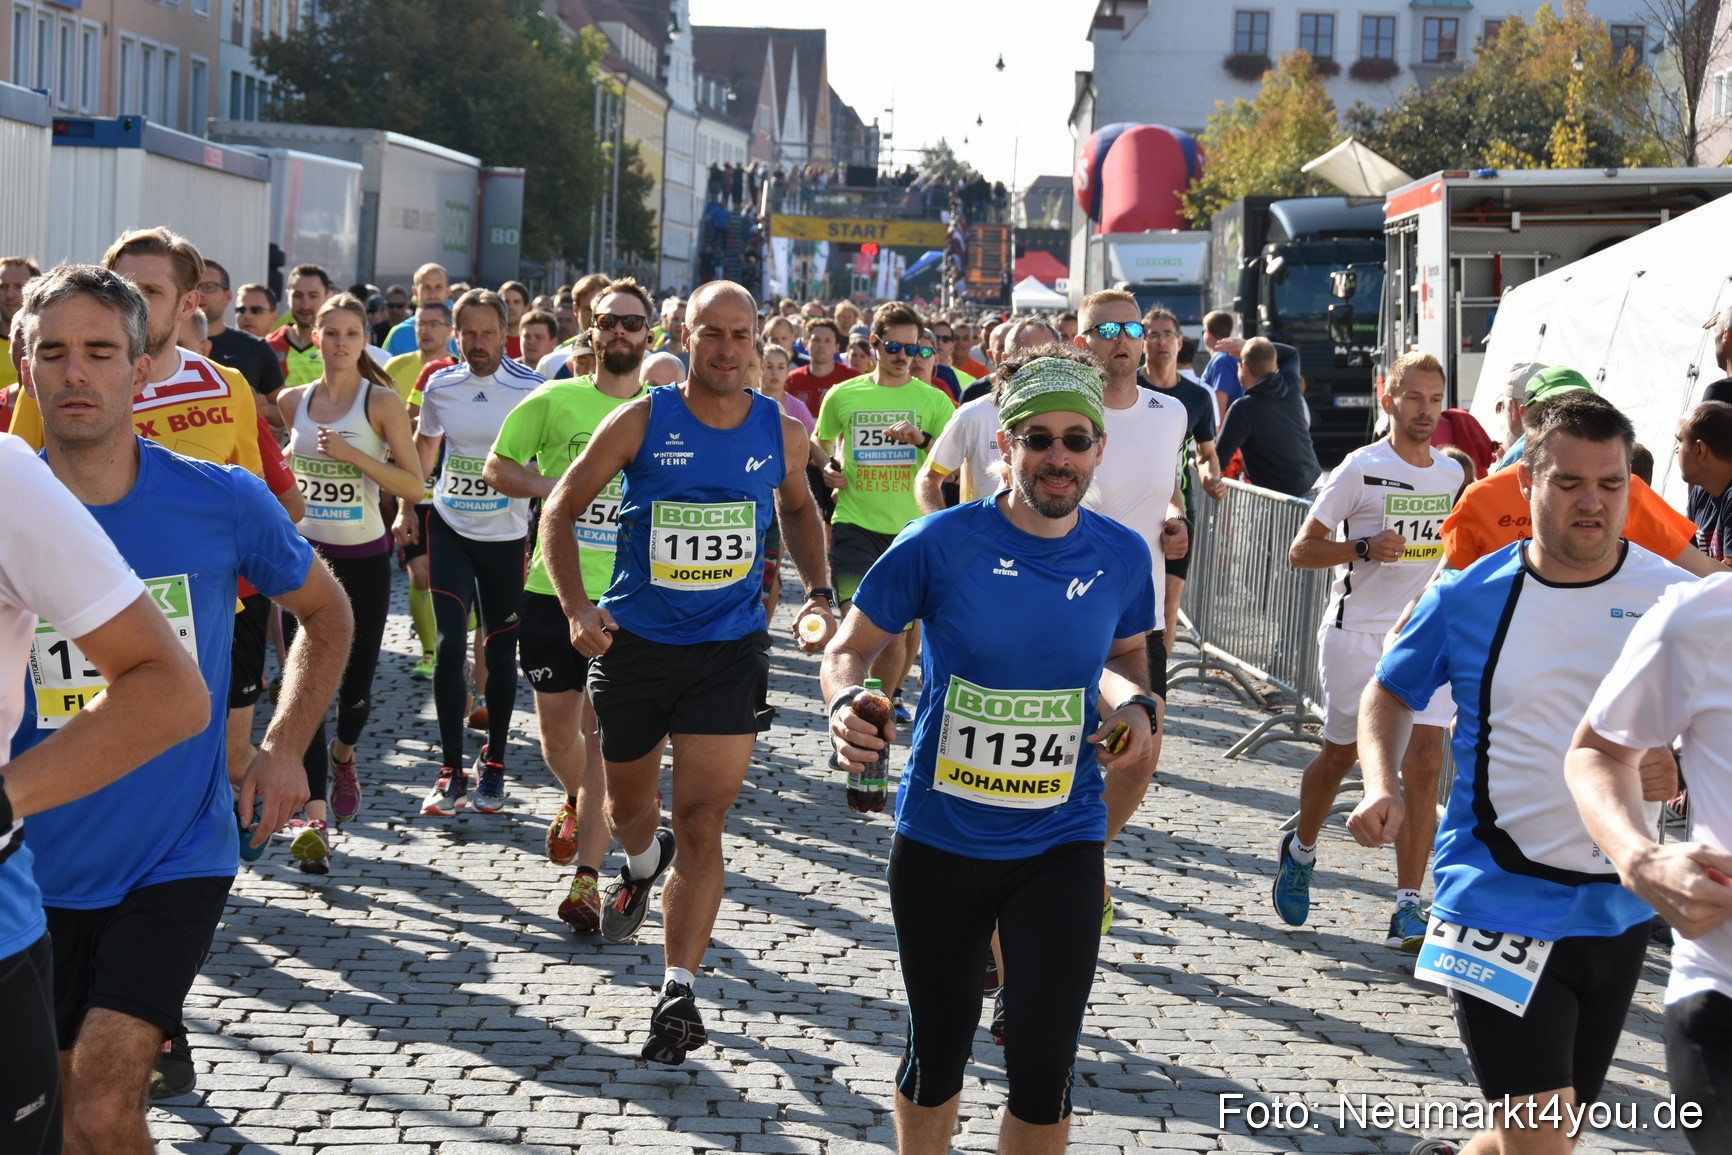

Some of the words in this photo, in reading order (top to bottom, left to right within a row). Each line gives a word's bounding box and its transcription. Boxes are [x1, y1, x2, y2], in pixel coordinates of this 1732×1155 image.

[828, 222, 888, 239] START
[167, 406, 234, 432] BÖGL
[857, 412, 909, 424] BOCK
[858, 450, 910, 459] CHRISTIAN
[294, 457, 357, 476] BOCK
[449, 456, 487, 474] BOC
[856, 469, 911, 480] PREMIUM
[297, 479, 355, 503] 2299
[856, 481, 911, 492] REISEN
[306, 506, 351, 518] ELANIE
[452, 501, 498, 511] JOHANN
[1391, 497, 1448, 513] BOCK
[661, 505, 746, 527] BOCK
[1393, 519, 1445, 541] 1142
[664, 534, 743, 561] 1133
[1402, 547, 1438, 558] HILIPP
[670, 568, 733, 580] JOCHEN
[993, 568, 1018, 577] erima
[179, 629, 187, 637] B
[955, 685, 1072, 721] BOCK
[958, 726, 1063, 768] 1134
[948, 768, 1061, 794] JOHANNES
[1434, 953, 1496, 983] JOSEF
